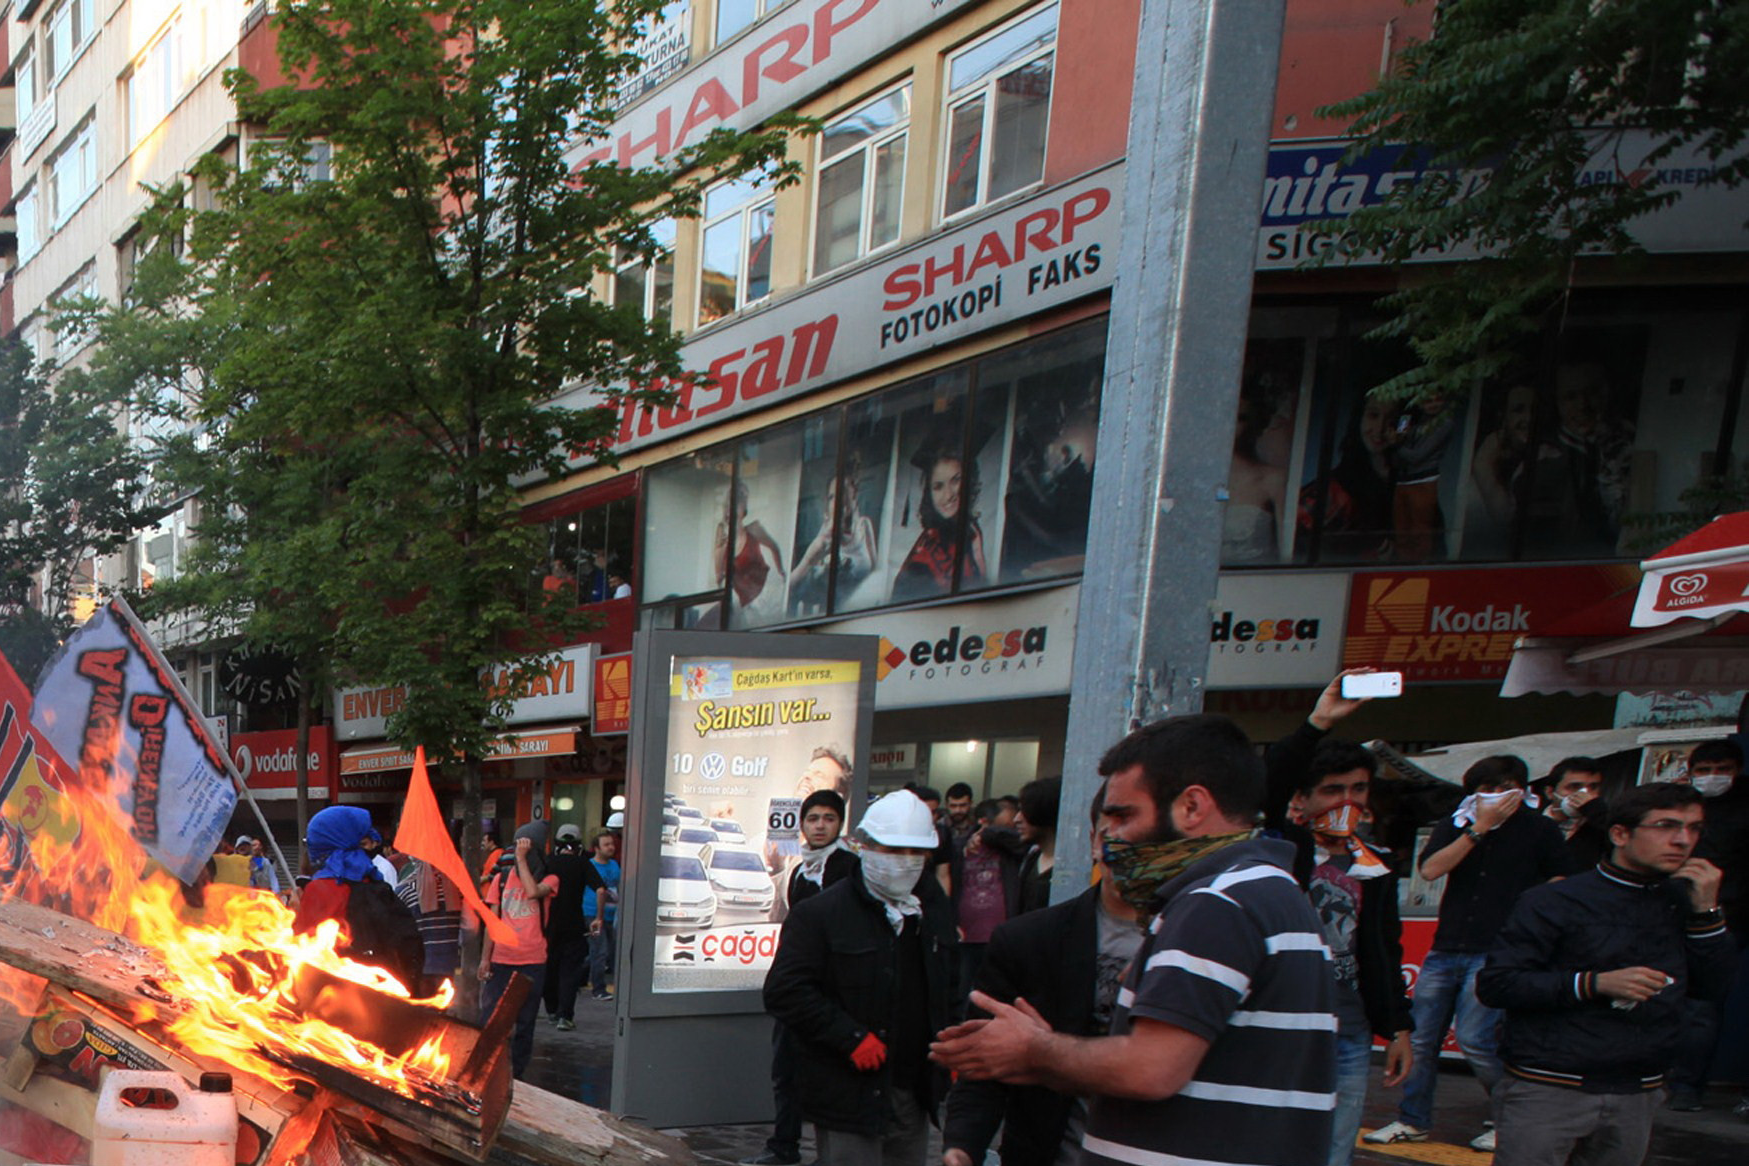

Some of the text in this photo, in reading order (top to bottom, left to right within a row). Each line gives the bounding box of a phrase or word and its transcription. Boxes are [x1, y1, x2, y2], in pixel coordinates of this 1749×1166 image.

[882, 187, 1111, 311] SHARP
[880, 244, 1101, 349] FOTOKOPİ FAKS
[1430, 604, 1532, 633] Kodak
[1666, 595, 1705, 608] ALGIDA
[1211, 610, 1320, 643] dessa
[909, 626, 1048, 667] edessa
[910, 656, 1044, 681] FOTOĞRAF
[343, 686, 407, 721] ENVER
[695, 697, 831, 738] Şansın var...
[672, 753, 693, 774] 10
[731, 756, 769, 777] Golf
[768, 811, 796, 829] 60
[701, 929, 776, 965] çağd
